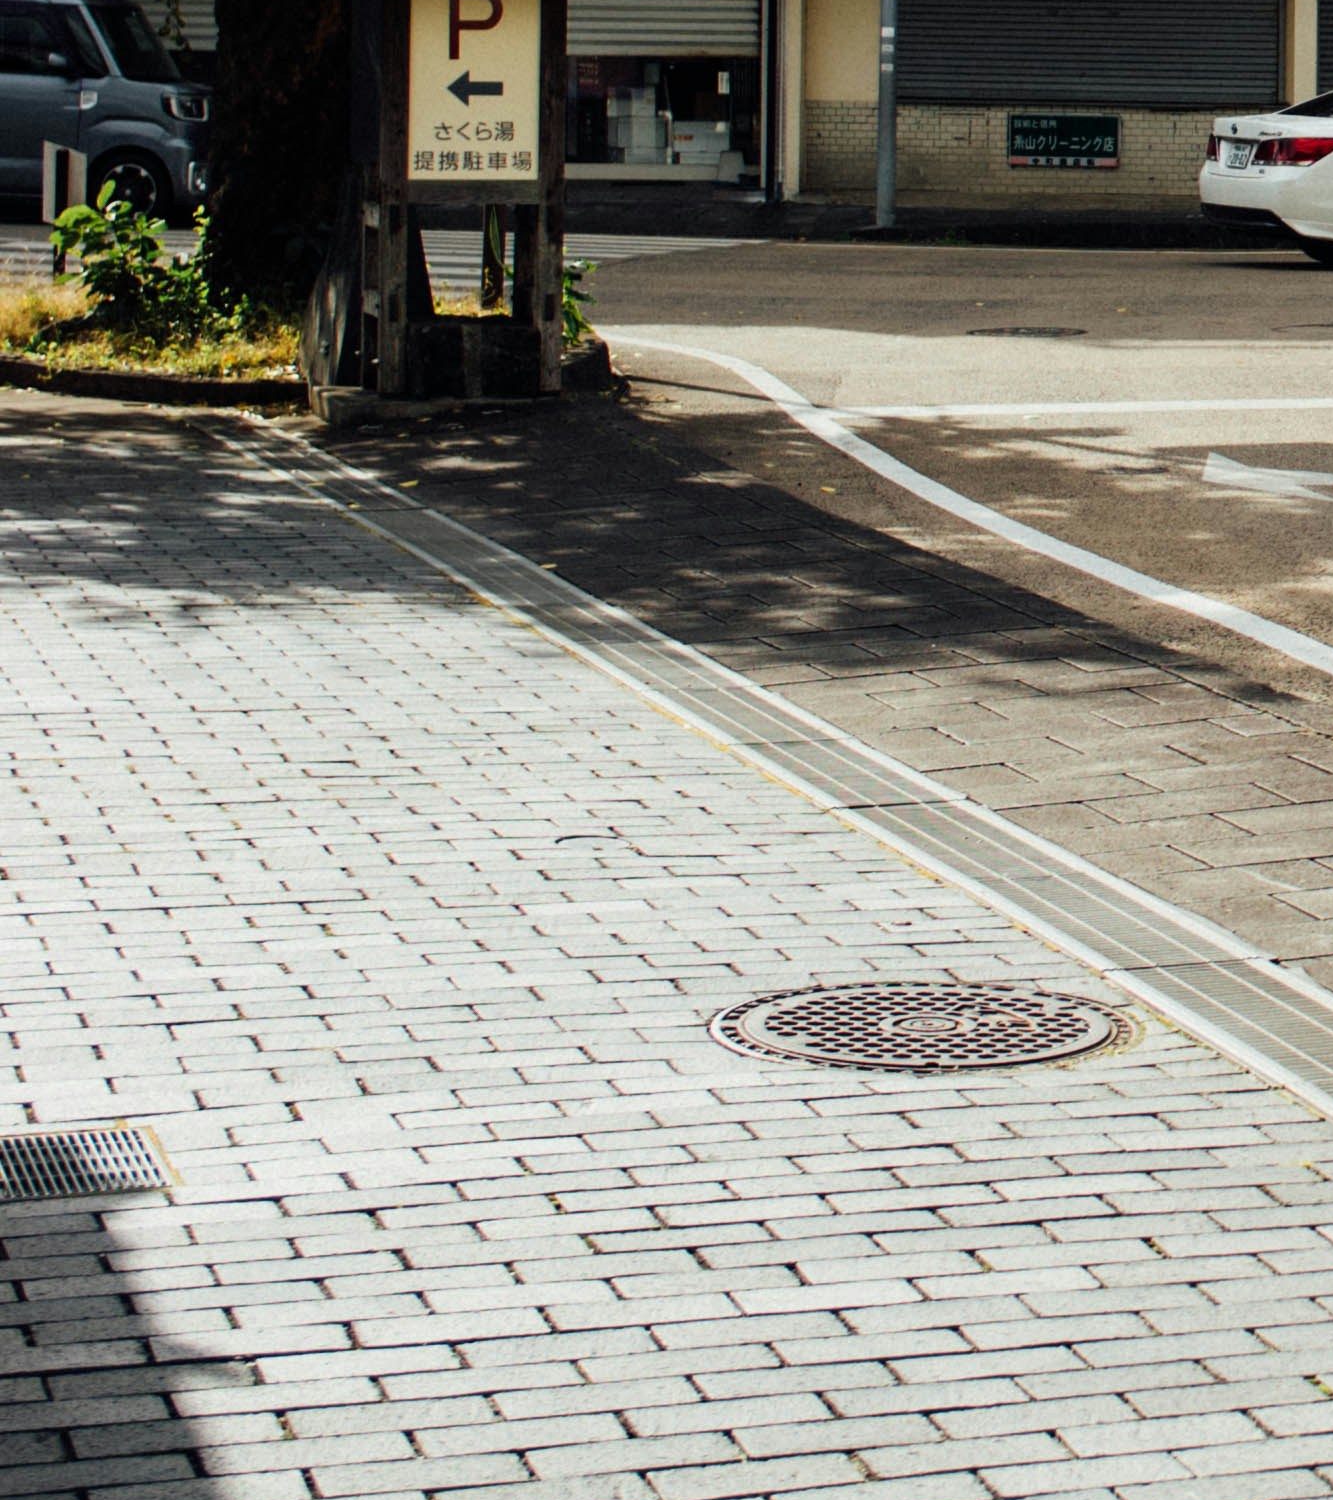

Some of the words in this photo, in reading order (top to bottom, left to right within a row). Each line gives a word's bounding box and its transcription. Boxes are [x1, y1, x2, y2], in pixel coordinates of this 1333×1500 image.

[433, 121, 515, 141] さくら湯
[413, 151, 532, 171] 提携駐車場
